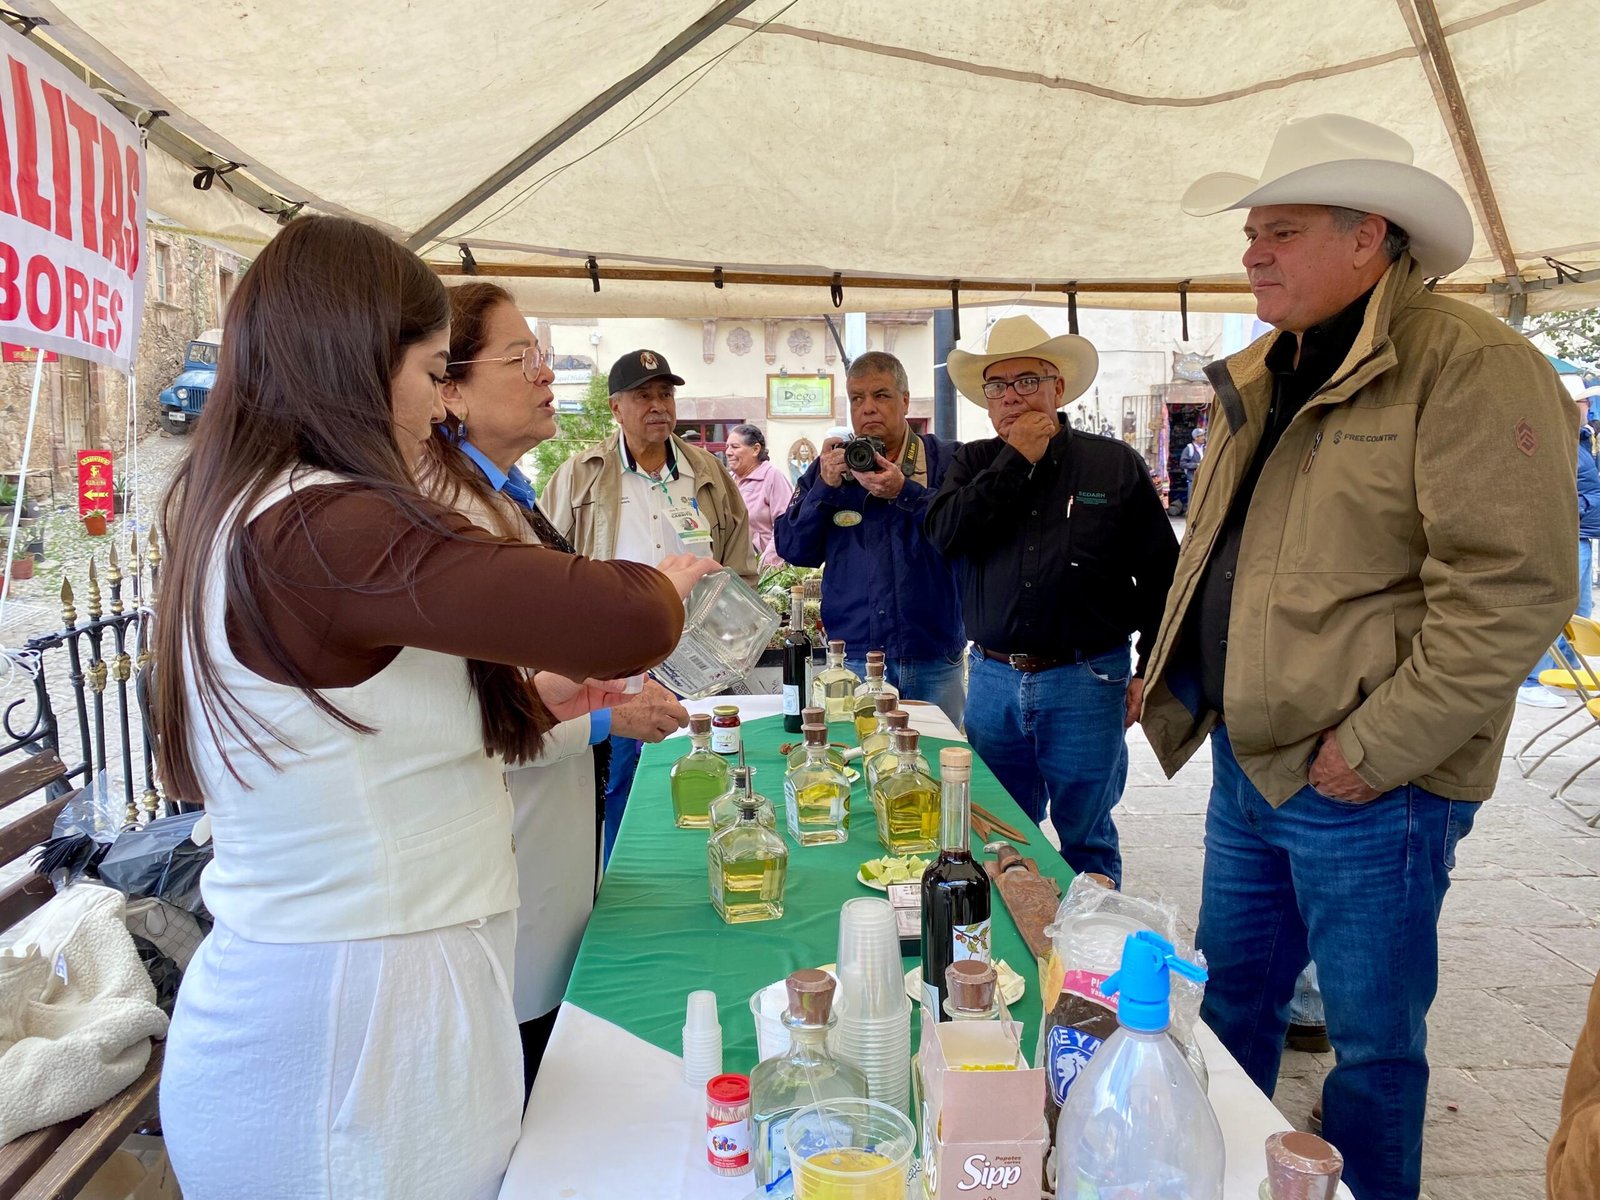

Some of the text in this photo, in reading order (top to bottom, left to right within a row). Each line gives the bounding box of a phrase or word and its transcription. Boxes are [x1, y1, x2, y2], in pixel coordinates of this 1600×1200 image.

[784, 390, 817, 405] Diego
[1344, 433, 1399, 443] FREE COUNTRY
[957, 1154, 1022, 1191] Sipp
